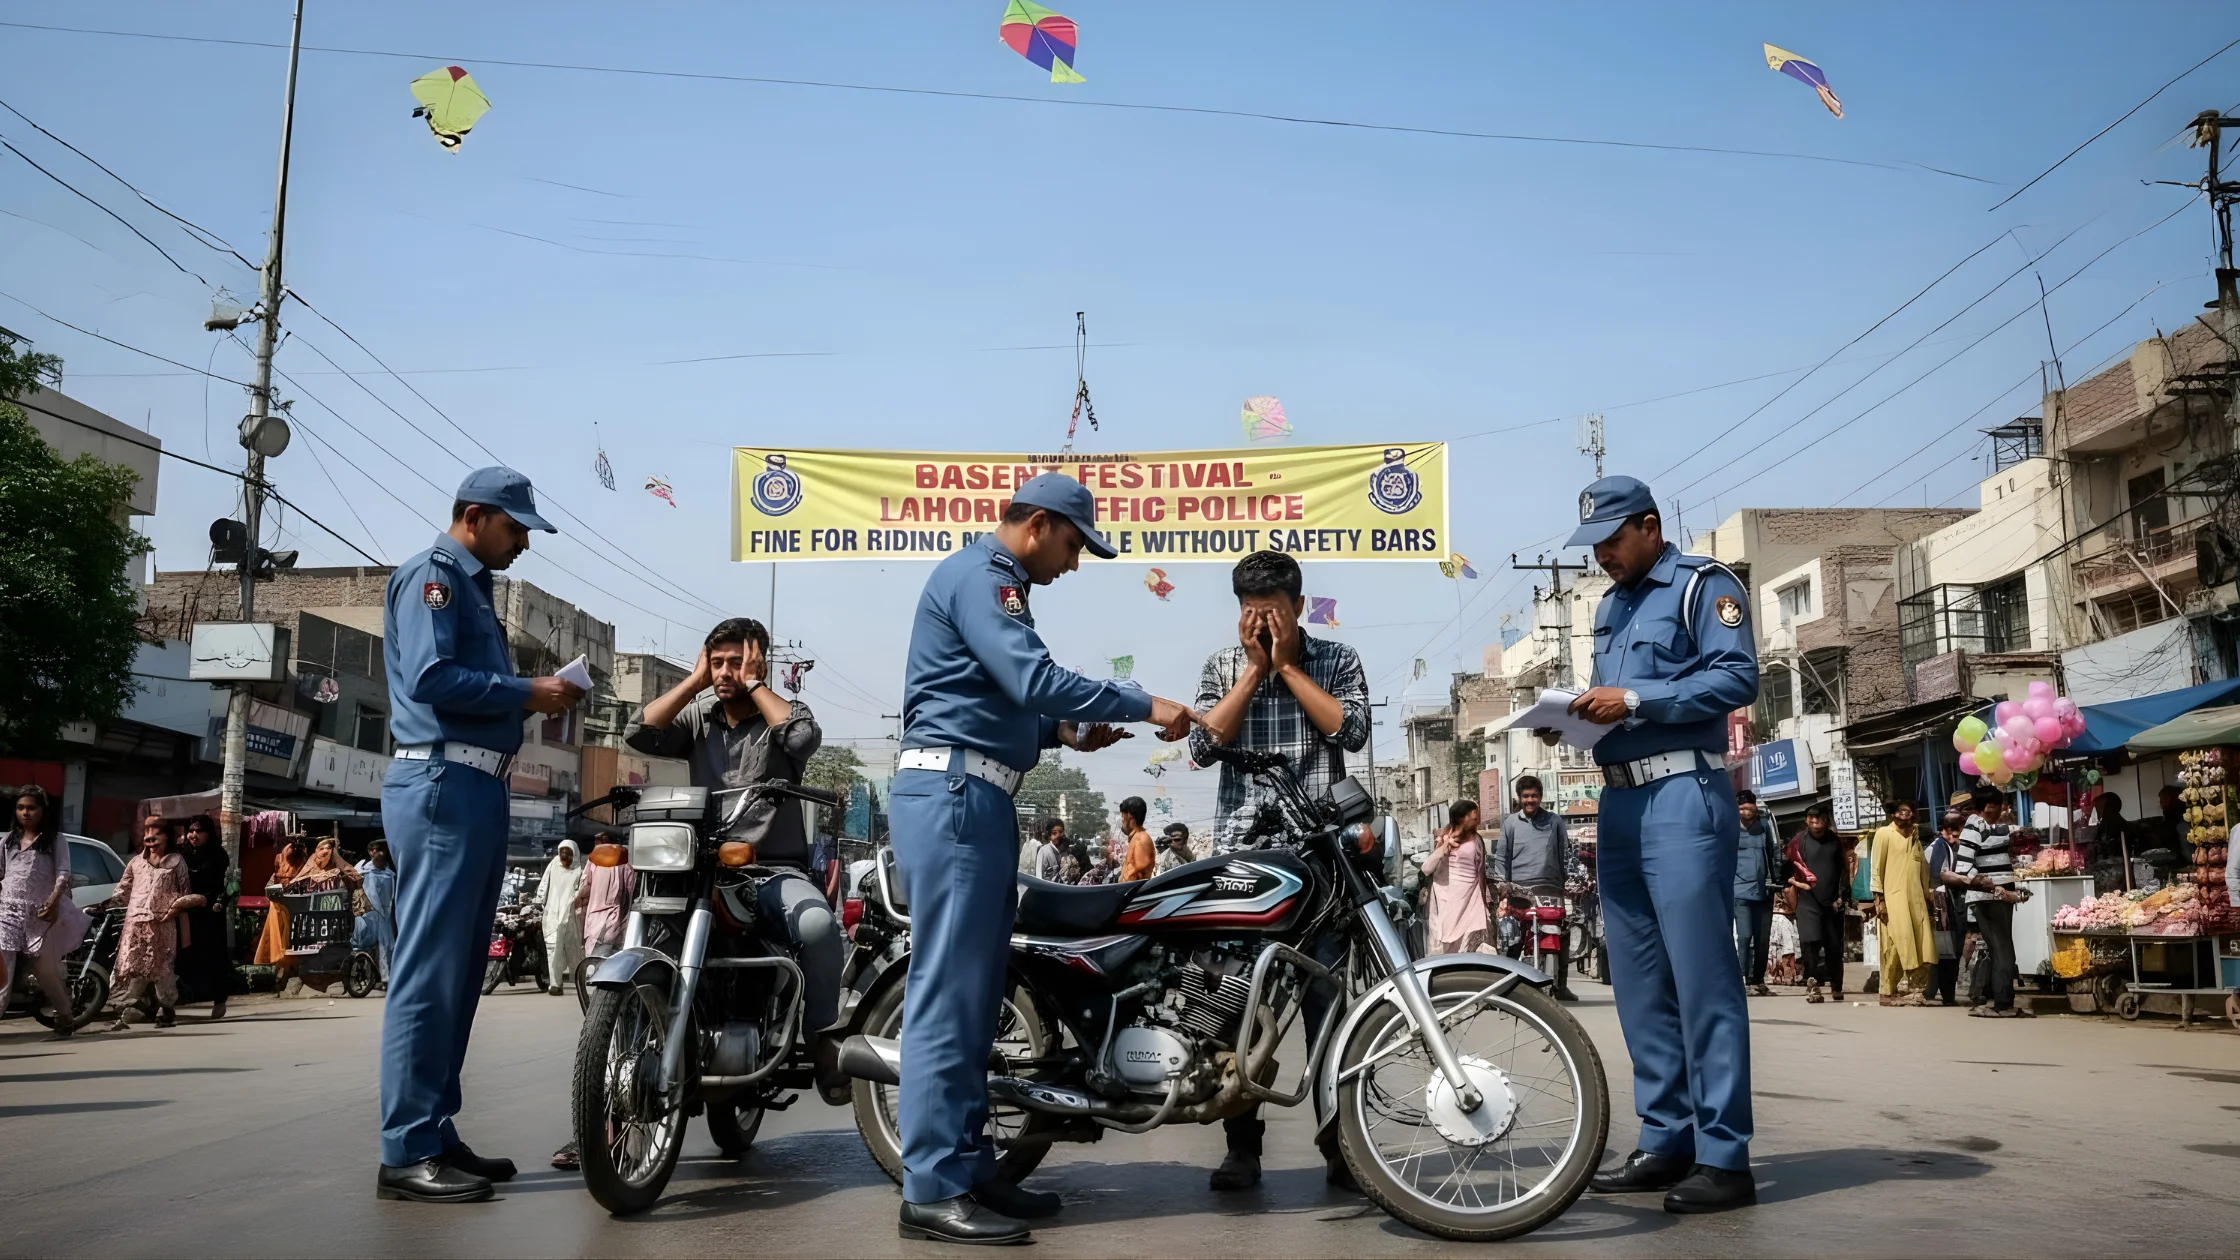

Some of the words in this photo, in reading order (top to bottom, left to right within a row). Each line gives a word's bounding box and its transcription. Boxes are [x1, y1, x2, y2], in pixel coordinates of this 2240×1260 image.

[915, 464, 1063, 491] BASEN
[1079, 463, 1253, 489] FESTIVAL
[1177, 495, 1303, 521] POLICE
[751, 531, 800, 553] FINE
[811, 530, 858, 552] FOR
[868, 530, 951, 551] RIDING
[1141, 531, 1260, 553] WITHOUT
[1269, 529, 1362, 552] SAFETY
[1372, 529, 1437, 551] BARS
